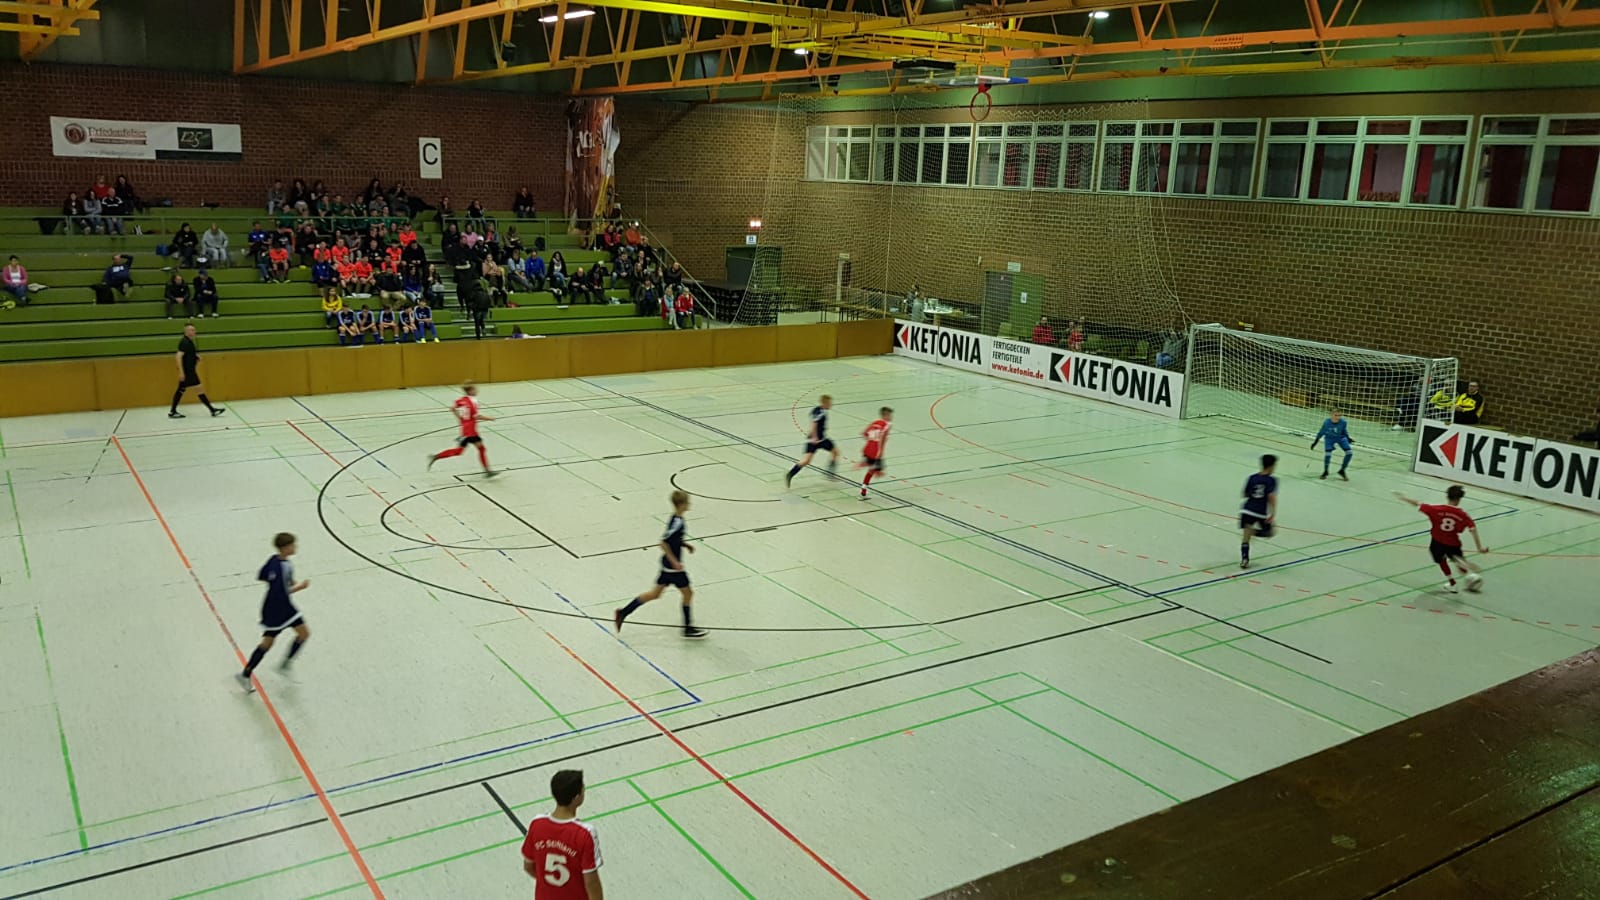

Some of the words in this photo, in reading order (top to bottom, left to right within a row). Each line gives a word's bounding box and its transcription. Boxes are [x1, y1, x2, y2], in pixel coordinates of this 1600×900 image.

[423, 143, 438, 165] C
[910, 325, 982, 365] KETONIA
[993, 340, 1031, 355] FERTIGDECKEN
[992, 350, 1023, 365] FERTIGTEILE
[991, 363, 1044, 380] www.ketonia.de
[1073, 357, 1172, 408] KETONIA
[1462, 433, 1600, 501] KETON
[1440, 517, 1456, 532] 8
[544, 853, 570, 887] 5
